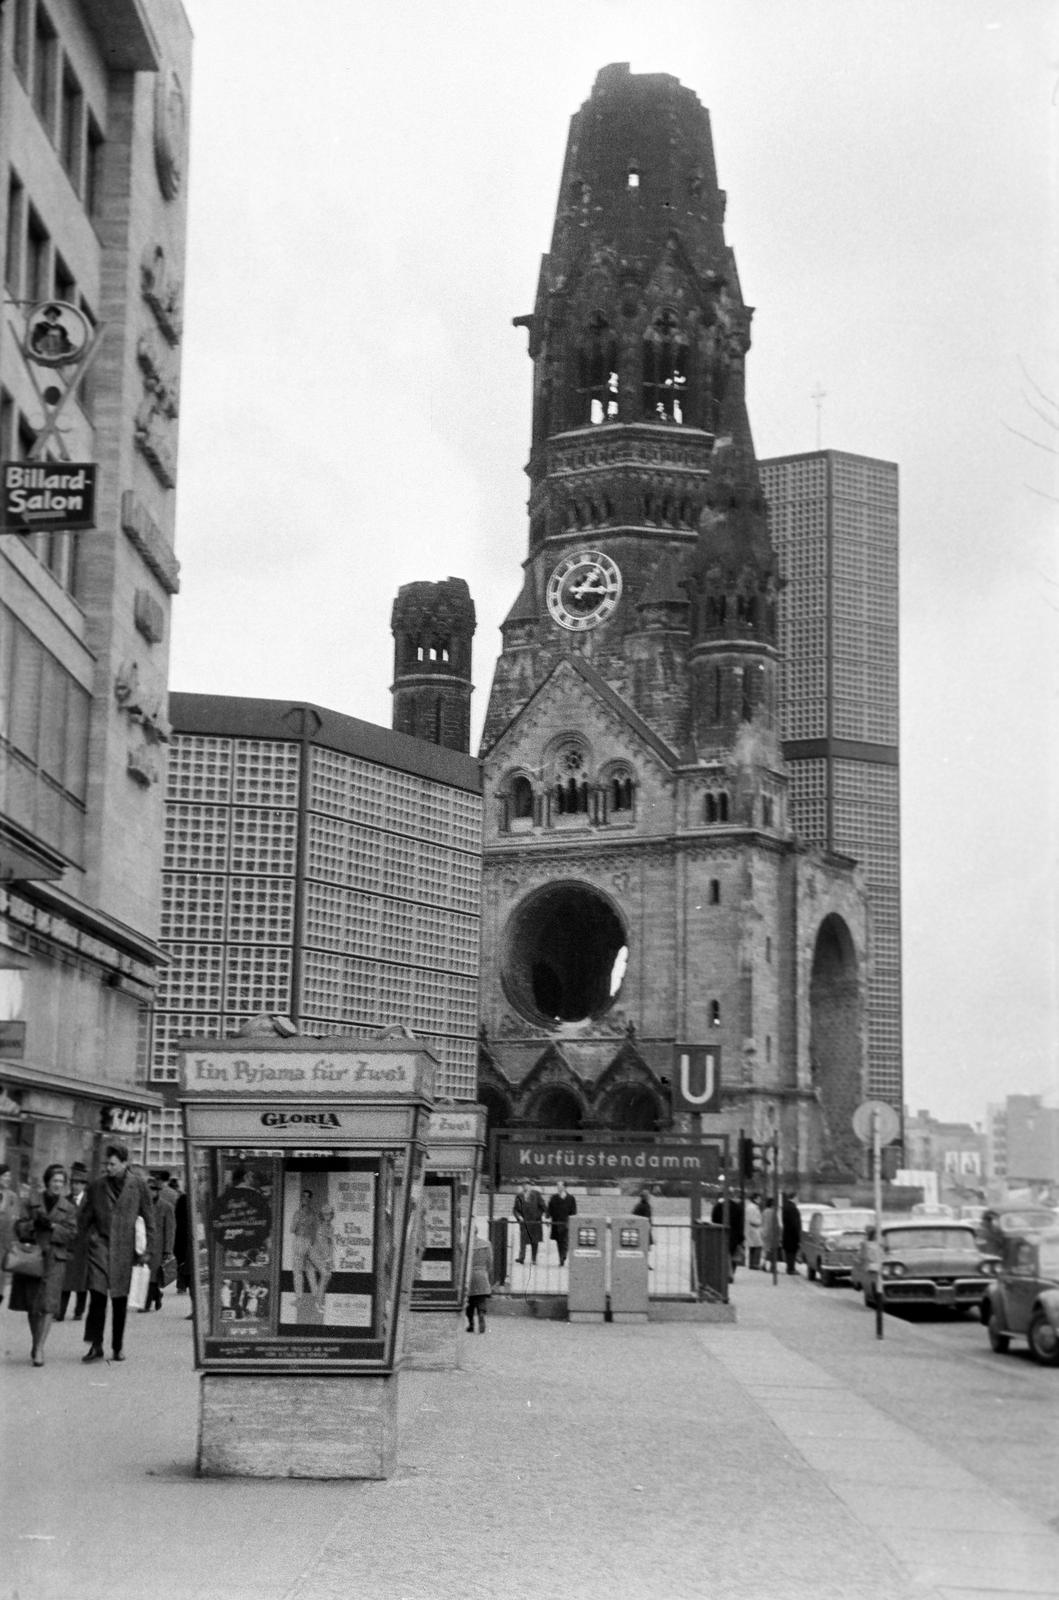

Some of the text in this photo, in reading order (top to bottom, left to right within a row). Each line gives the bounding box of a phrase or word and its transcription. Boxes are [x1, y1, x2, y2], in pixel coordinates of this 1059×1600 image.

[6, 467, 92, 490] Billard-
[8, 490, 83, 513] Salon
[194, 1059, 406, 1083] Ein Pyjama für Zwei
[681, 1054, 713, 1104] U
[261, 1112, 342, 1127] GLORIA
[519, 1147, 701, 1169] Kurfürstendamm
